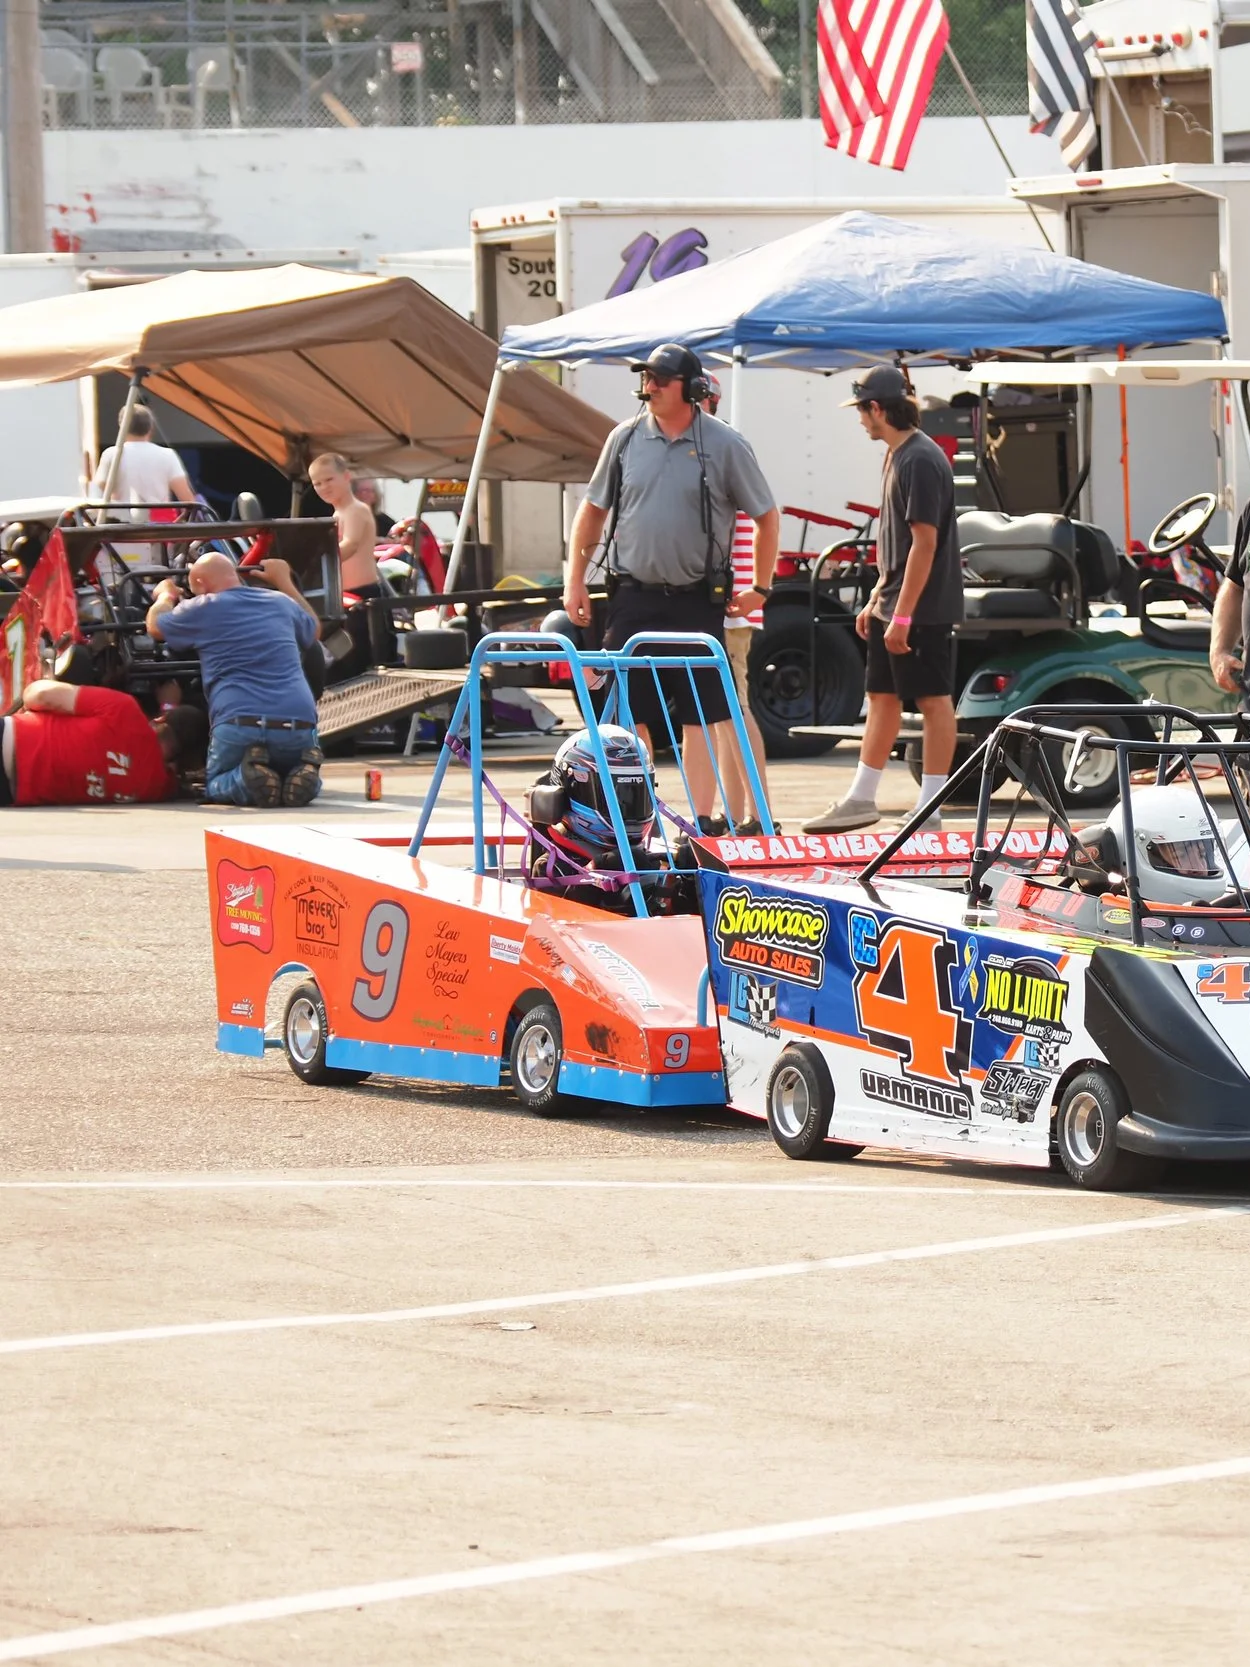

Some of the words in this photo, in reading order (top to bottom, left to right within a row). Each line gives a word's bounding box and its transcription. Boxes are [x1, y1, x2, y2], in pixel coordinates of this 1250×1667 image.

[617, 776, 644, 784] zamp
[718, 838, 764, 862] BIG
[770, 837, 826, 860] AL'S
[947, 833, 971, 854] &
[435, 920, 460, 941] Lew
[719, 898, 823, 940] Showcase
[296, 943, 338, 960] INSULATION
[351, 899, 410, 1023] 9
[425, 942, 467, 965] Meyers
[729, 941, 768, 965] AUTO
[770, 951, 812, 977] SALES
[426, 961, 469, 985] Special
[983, 967, 1011, 1013] NO
[1012, 973, 1067, 1023] LIMIT
[1025, 1023, 1043, 1037] KARTS
[1052, 1028, 1072, 1043] PARTS
[663, 1033, 691, 1068] 9
[863, 1072, 970, 1118] URMANIC
[981, 1065, 1050, 1100] SWEET
